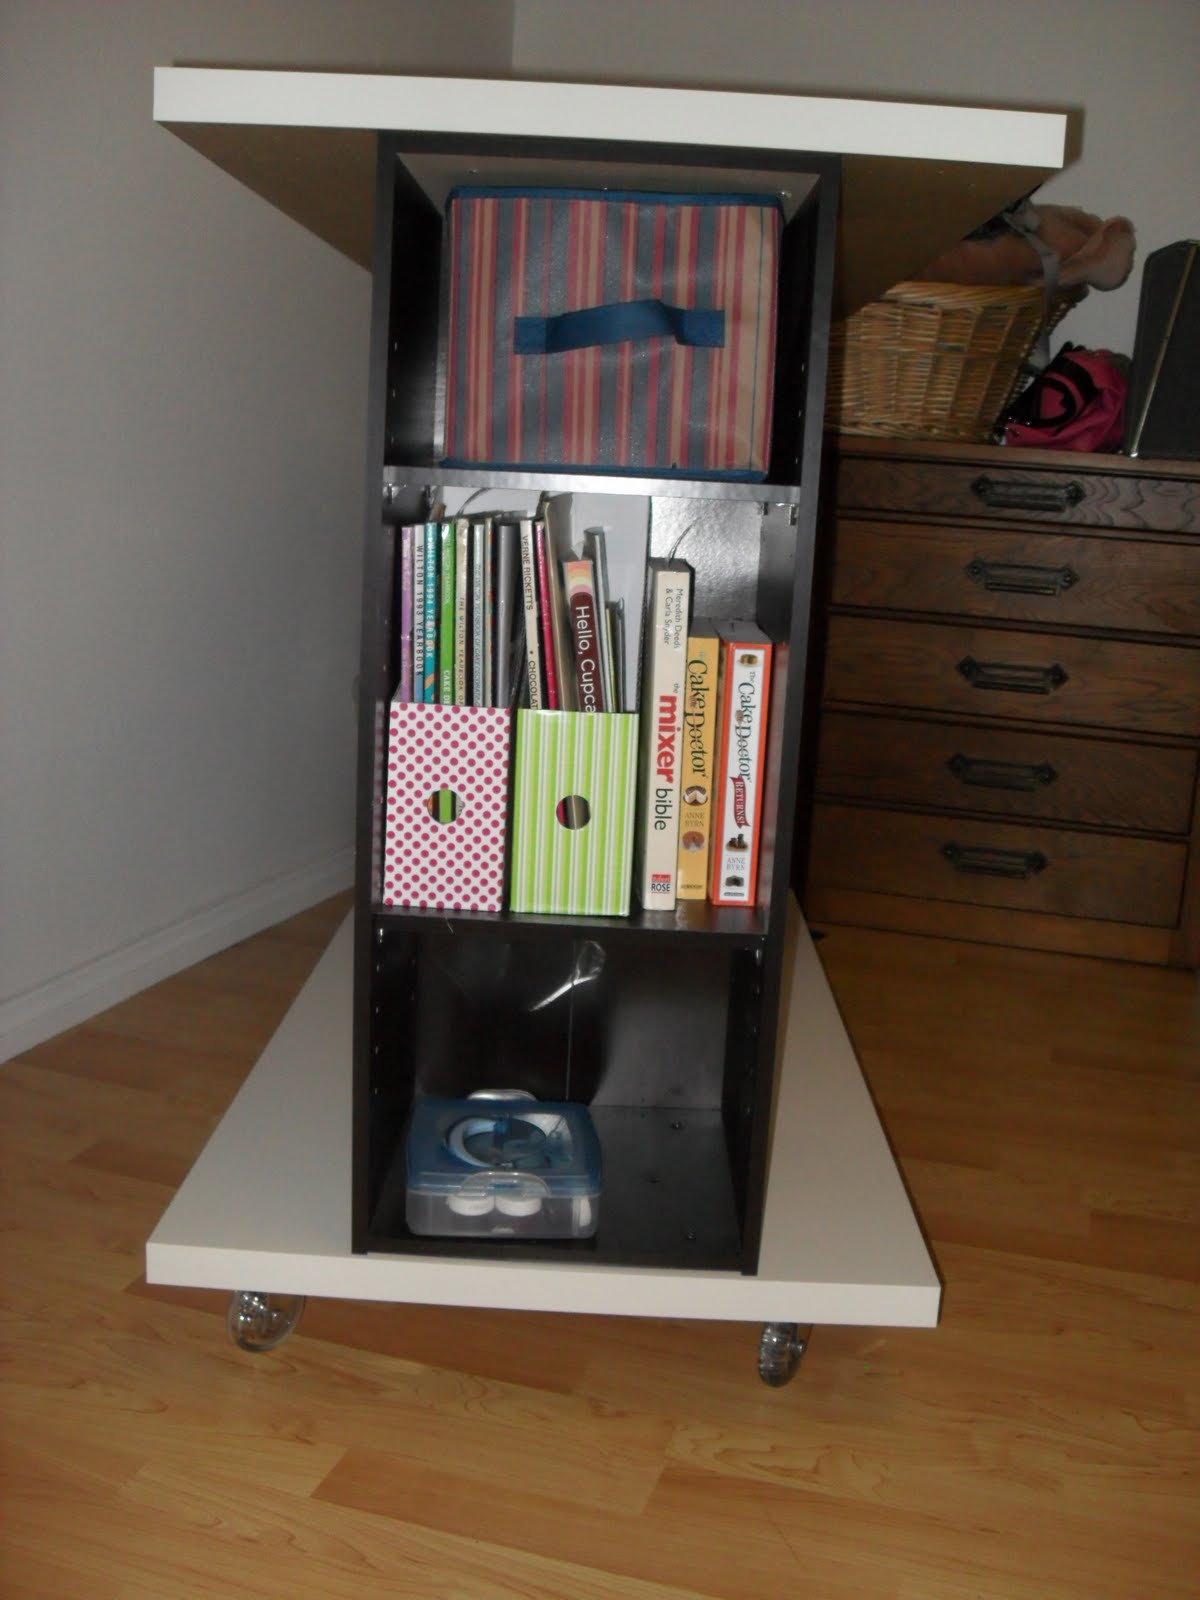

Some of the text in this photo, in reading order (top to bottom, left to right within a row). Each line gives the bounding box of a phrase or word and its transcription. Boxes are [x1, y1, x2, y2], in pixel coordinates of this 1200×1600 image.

[522, 535, 531, 565] VERNE
[416, 545, 424, 675] WILTON 1993 YEARBOOK
[427, 583, 435, 605] 1994
[524, 567, 534, 611] RICKETTS
[575, 605, 593, 655] Hello,
[663, 618, 672, 645] Snyder
[673, 588, 684, 649] Meredith Deeds
[443, 669, 451, 692] CAKE
[687, 659, 710, 709] Cake
[738, 682, 756, 724] Cake
[657, 695, 681, 784] mixer
[684, 711, 707, 778] Doctor
[734, 725, 753, 782] Doctor
[654, 788, 674, 831] bible
[735, 780, 745, 825] RETURNS!
[651, 882, 671, 892] ROSE
